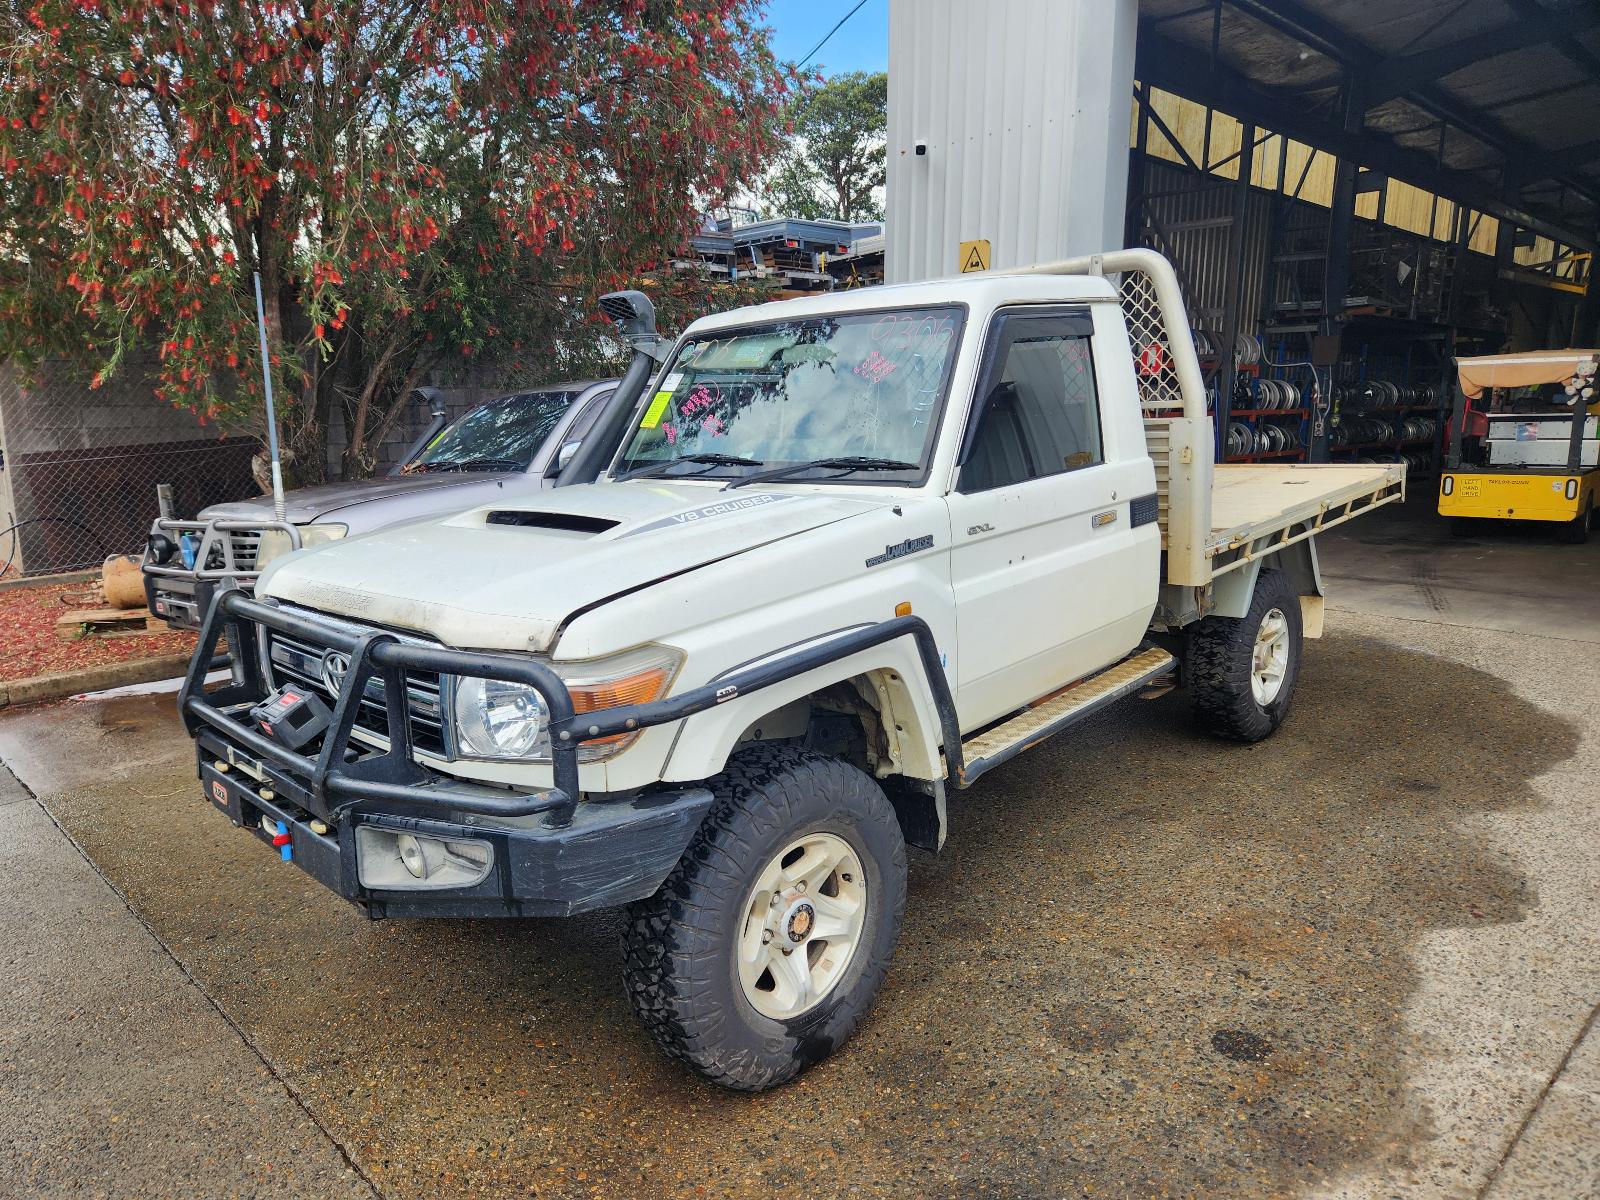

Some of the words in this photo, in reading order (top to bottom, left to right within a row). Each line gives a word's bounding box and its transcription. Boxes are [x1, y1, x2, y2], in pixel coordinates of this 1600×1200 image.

[672, 512, 700, 523] V8
[702, 495, 775, 517] CRUISER
[966, 523, 996, 536] GXL
